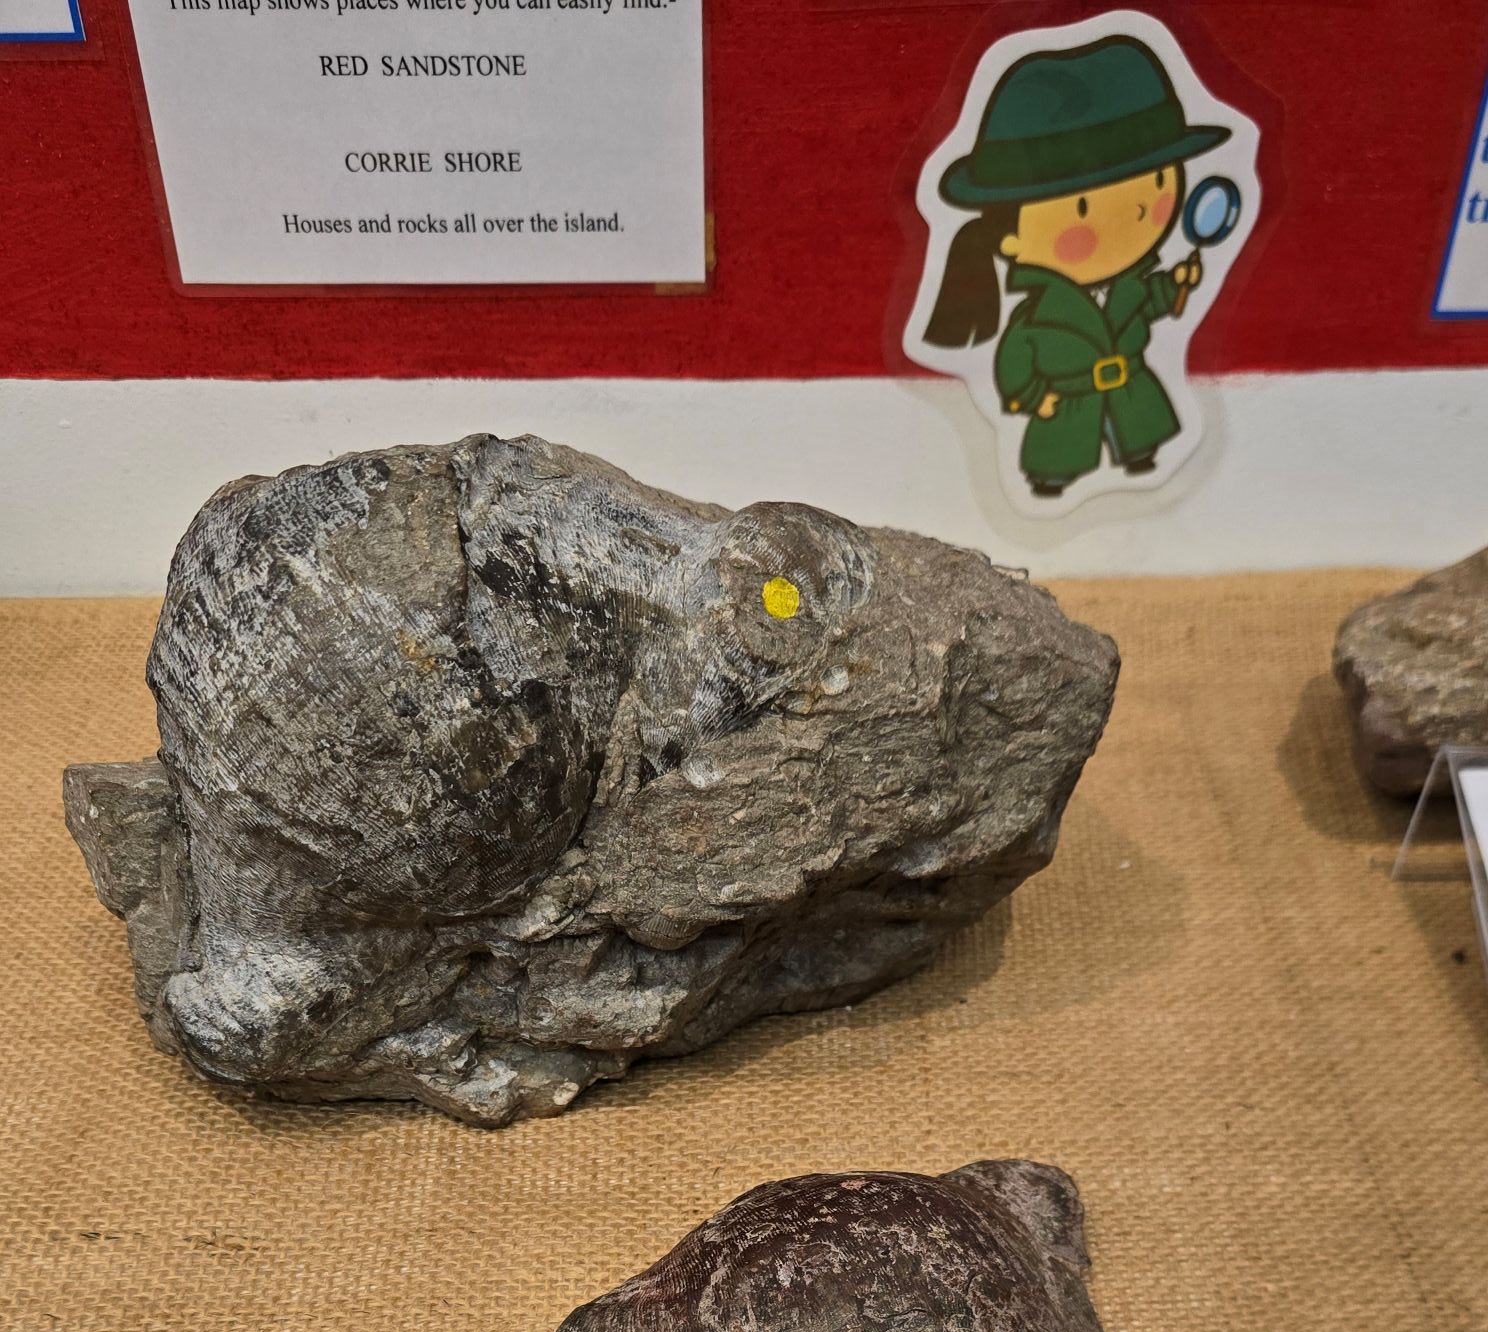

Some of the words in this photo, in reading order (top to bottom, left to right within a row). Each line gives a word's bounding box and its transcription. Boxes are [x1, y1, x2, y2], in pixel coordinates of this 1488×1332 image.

[217, 0, 261, 15] map
[472, 0, 511, 15] you
[515, 0, 552, 10] can
[318, 54, 369, 77] RED
[381, 54, 528, 77] SANDSTONE
[344, 151, 433, 173] CORRIE
[444, 151, 523, 173] SHORE
[281, 213, 353, 234] Houses
[357, 213, 392, 234] and
[396, 212, 449, 234] rocks
[453, 212, 477, 234] all
[482, 217, 525, 234] over
[529, 212, 559, 233] the
[564, 211, 625, 233] island.
